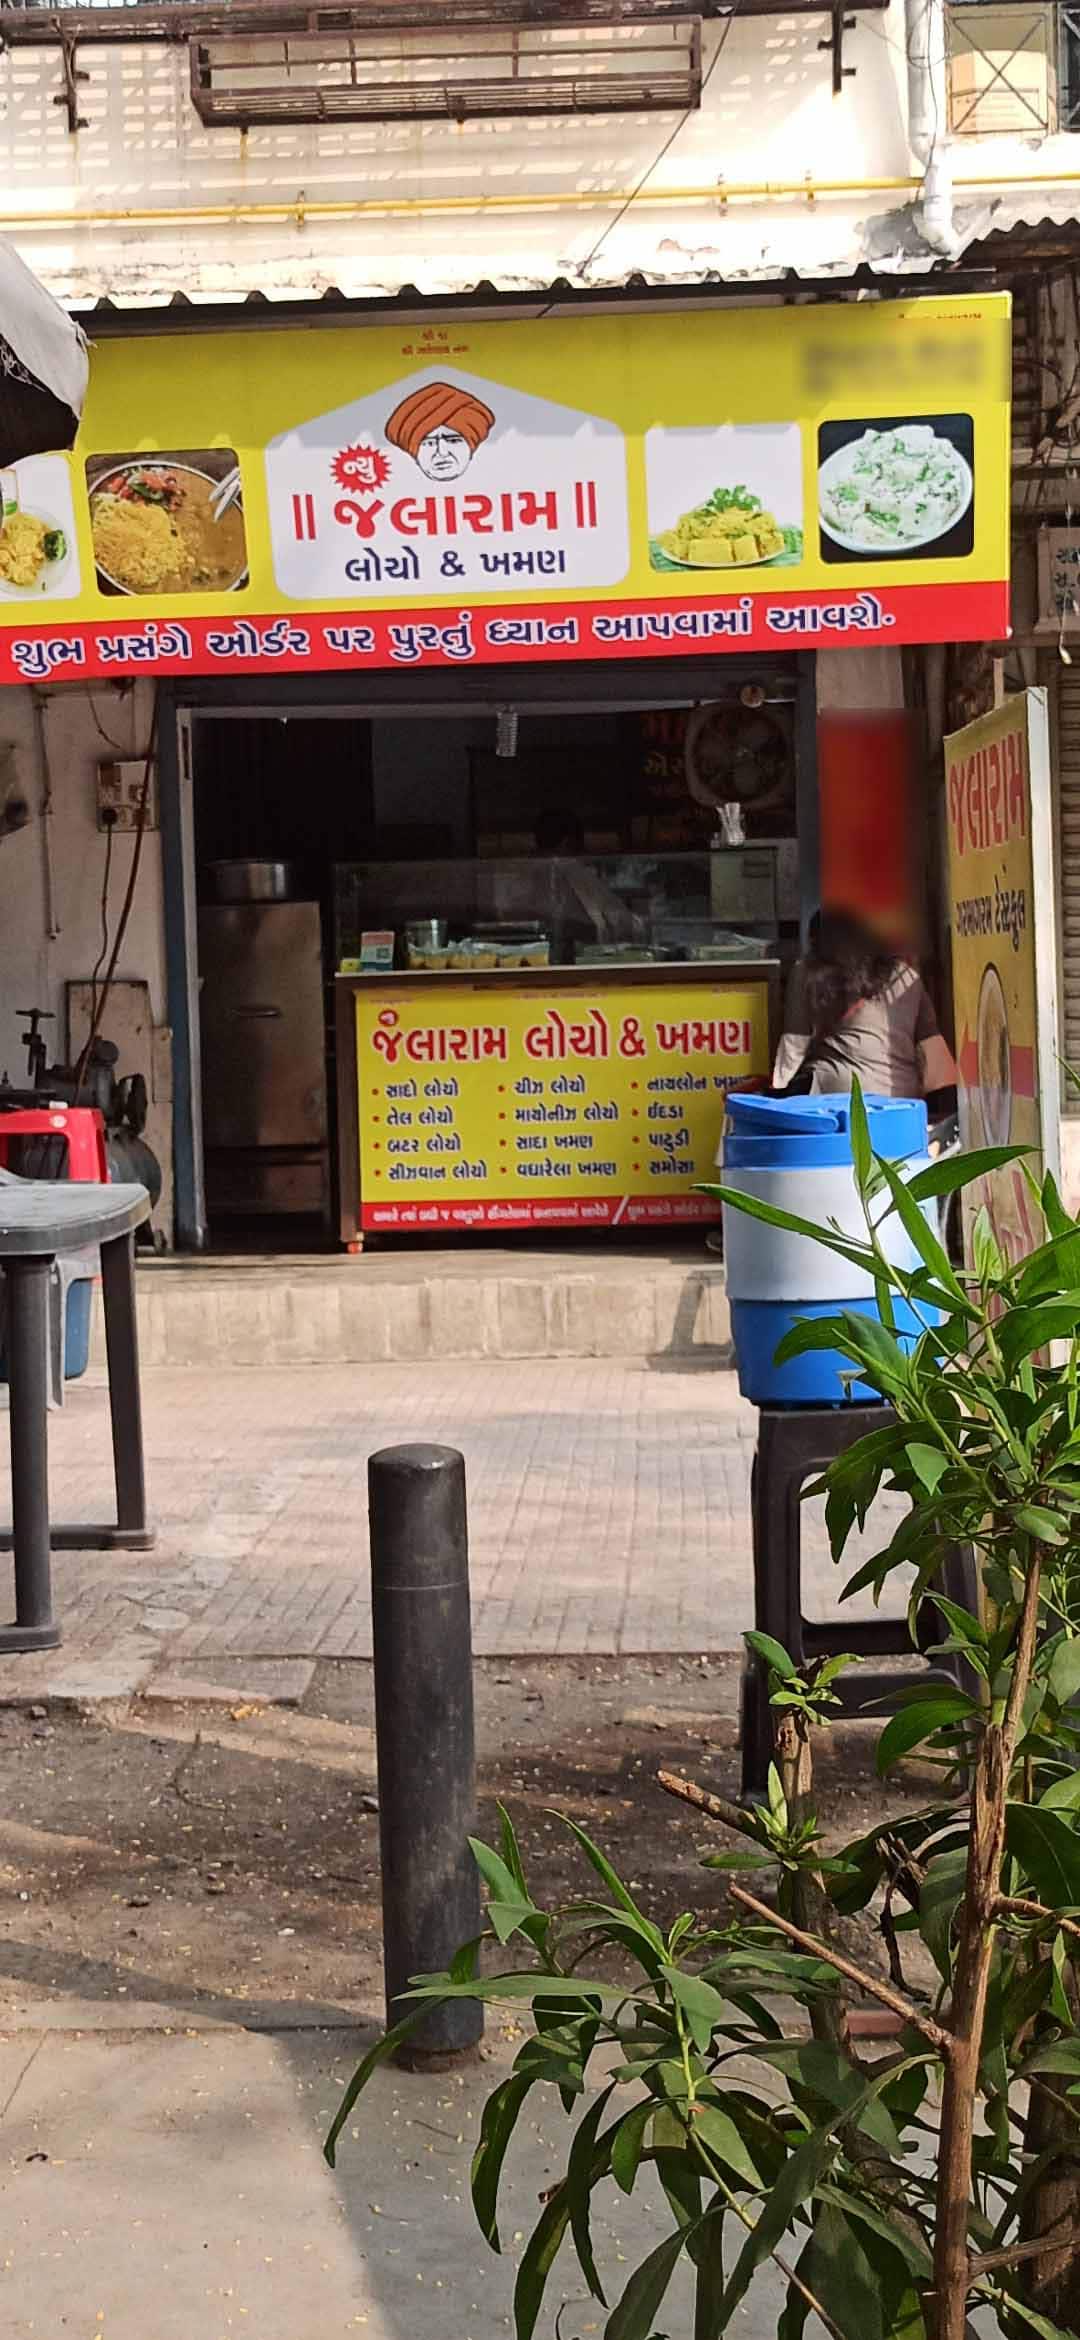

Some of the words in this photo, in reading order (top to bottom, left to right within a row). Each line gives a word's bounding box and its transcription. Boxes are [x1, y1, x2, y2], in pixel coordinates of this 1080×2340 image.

[334, 490, 558, 539] જલારામ
[345, 546, 419, 581] લોચો
[440, 551, 466, 577] &
[480, 550, 566, 575] ખમણ
[12, 640, 83, 675] શુભ
[98, 625, 191, 661] પ્રસંગે
[207, 621, 310, 658] ઓર્ડર
[324, 626, 375, 652] પર
[388, 612, 474, 660] પુરતું
[486, 617, 577, 646] ધ્યાન
[593, 598, 752, 640] આપવામાં
[767, 594, 896, 631] આવશે.
[950, 730, 1027, 856] જલારામ
[372, 1026, 507, 1063] જલારામ
[525, 1008, 609, 1059] લોચો
[619, 1017, 646, 1056] &
[656, 1021, 751, 1055] ખમણ
[385, 1077, 418, 1099] સાદો
[424, 1076, 460, 1097] લોચો
[514, 1076, 545, 1095] ચીઝ
[551, 1074, 586, 1094] લોચો
[387, 1105, 413, 1126] તેલ
[418, 1104, 454, 1124] લોચો
[584, 1100, 619, 1121] લોચો
[387, 1138, 420, 1153] બટર
[426, 1132, 462, 1152] લોચો
[516, 1135, 548, 1150] સાદા
[554, 1135, 594, 1149] ખમણ
[388, 1162, 447, 1181] સીઝવાન
[452, 1159, 488, 1179] લોચો
[517, 1157, 572, 1177] વઘારેલા
[577, 1161, 618, 1176] ખમણ
[650, 1155, 695, 1175] સમોસા
